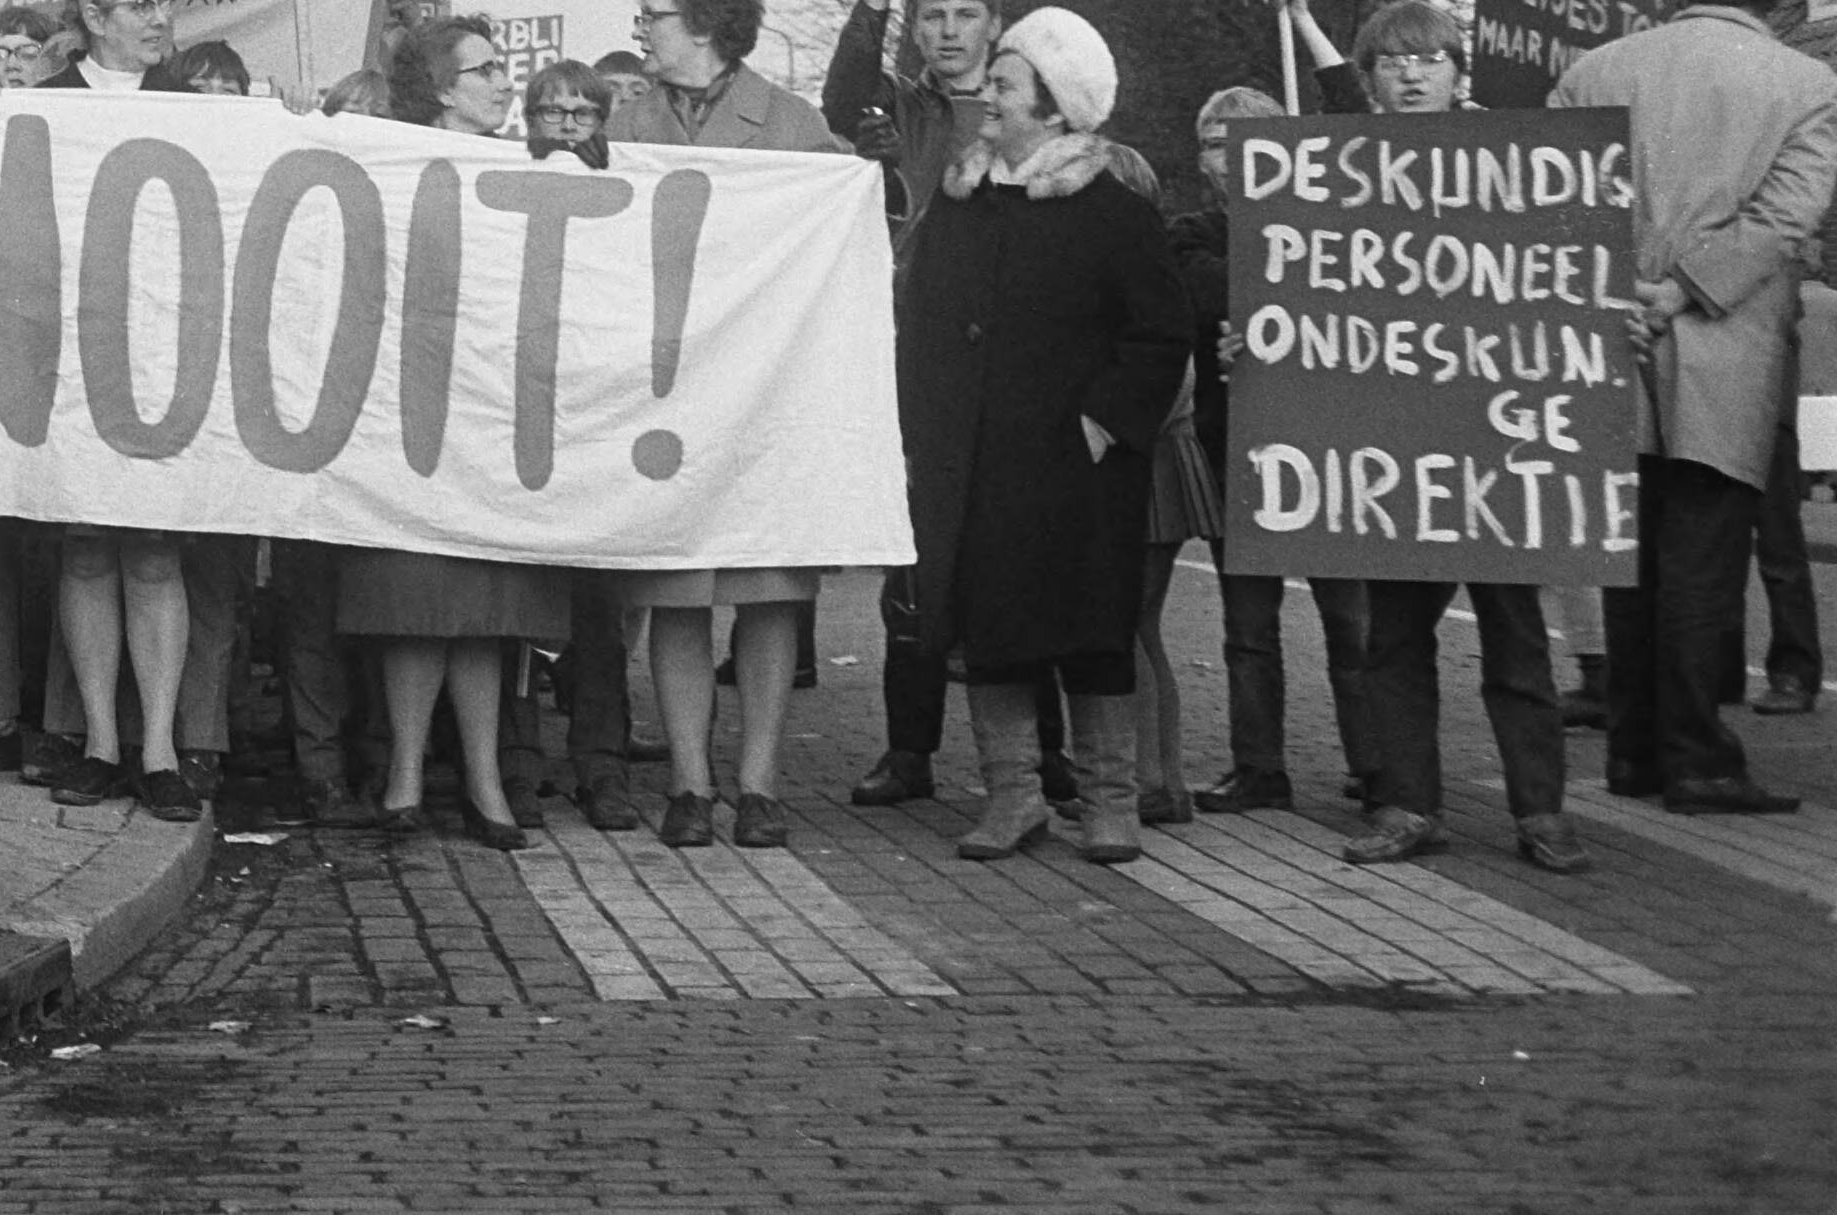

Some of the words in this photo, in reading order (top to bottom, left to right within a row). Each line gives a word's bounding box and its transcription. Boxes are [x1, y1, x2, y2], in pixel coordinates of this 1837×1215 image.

[1478, 15, 1542, 66] MAAR
[1242, 135, 1635, 218] DESKUNDIG
[1262, 224, 1643, 310] PERSONEEL
[1487, 389, 1581, 453] GE
[1247, 440, 1639, 552] DIREKTIE
